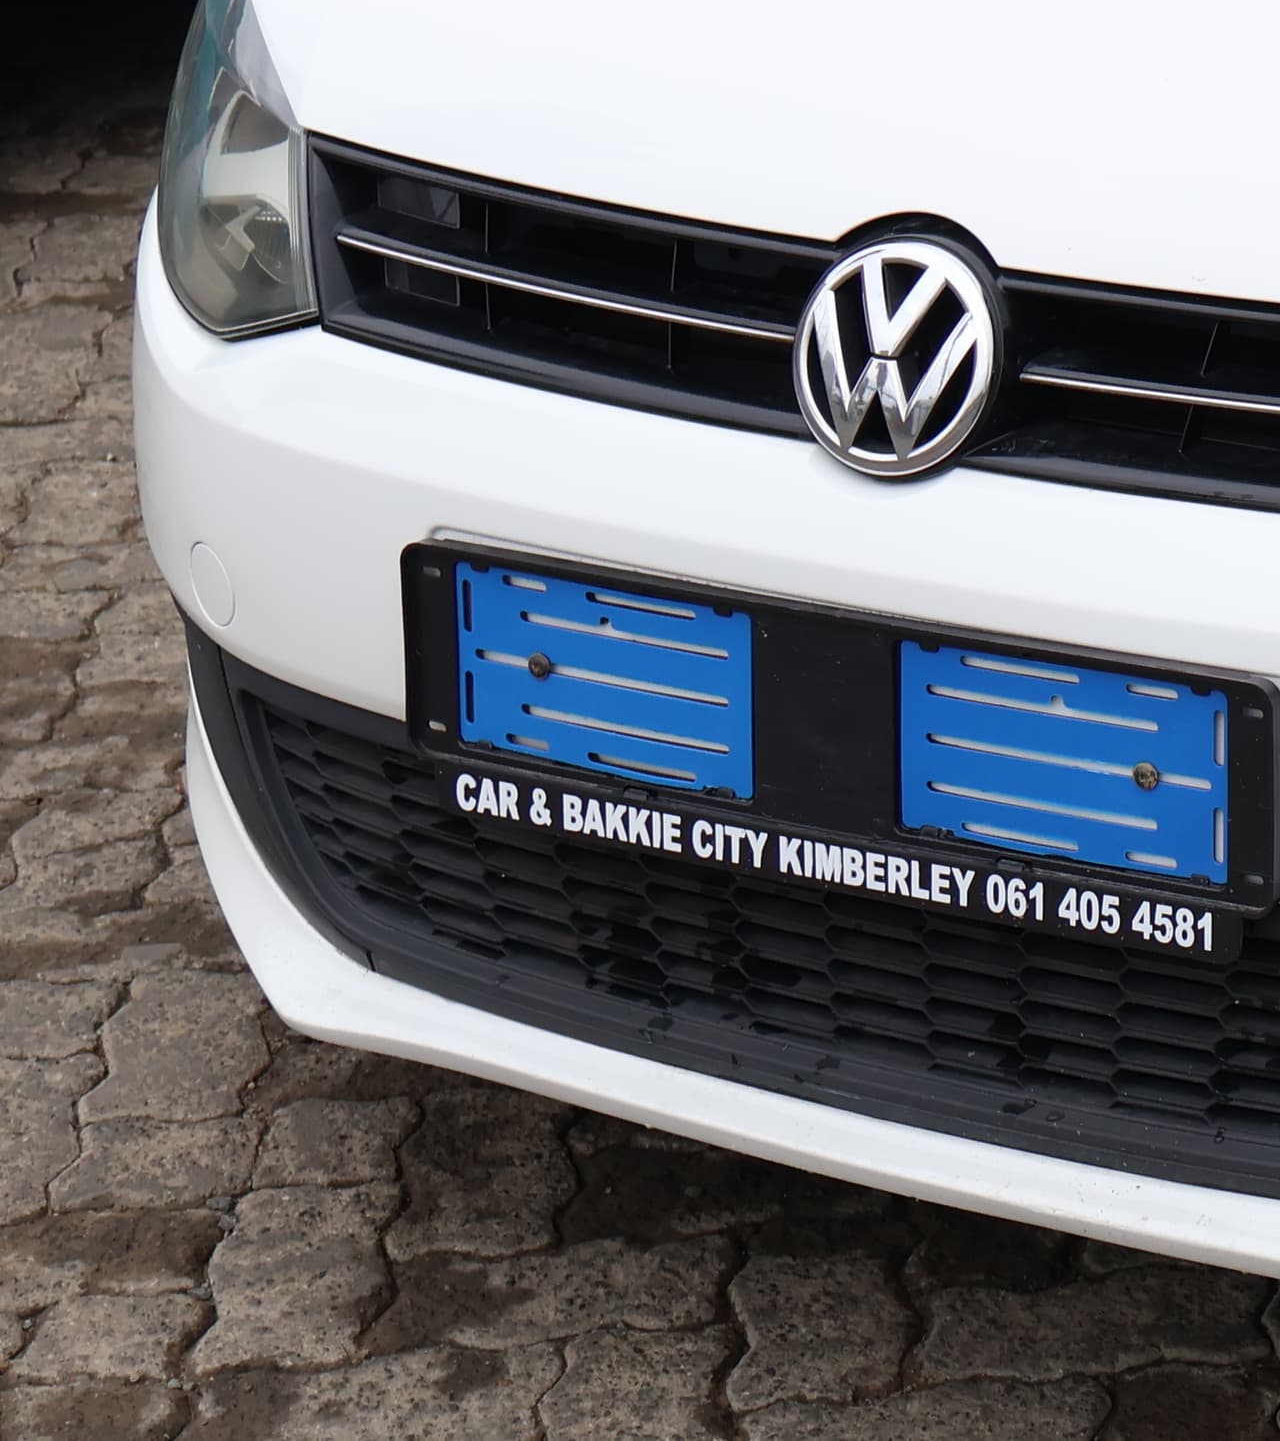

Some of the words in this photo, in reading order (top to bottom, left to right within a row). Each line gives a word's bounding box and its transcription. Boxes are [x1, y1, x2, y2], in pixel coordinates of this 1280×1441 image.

[800, 244, 992, 472] VW
[455, 773, 520, 821] CAR
[529, 788, 553, 828] &
[562, 793, 682, 854] BAKKIE
[692, 819, 768, 869] CITY
[778, 835, 975, 907] KIMBERLEY
[985, 874, 1044, 921] 061
[1057, 887, 1121, 935] 405
[1131, 900, 1215, 952] 4581
